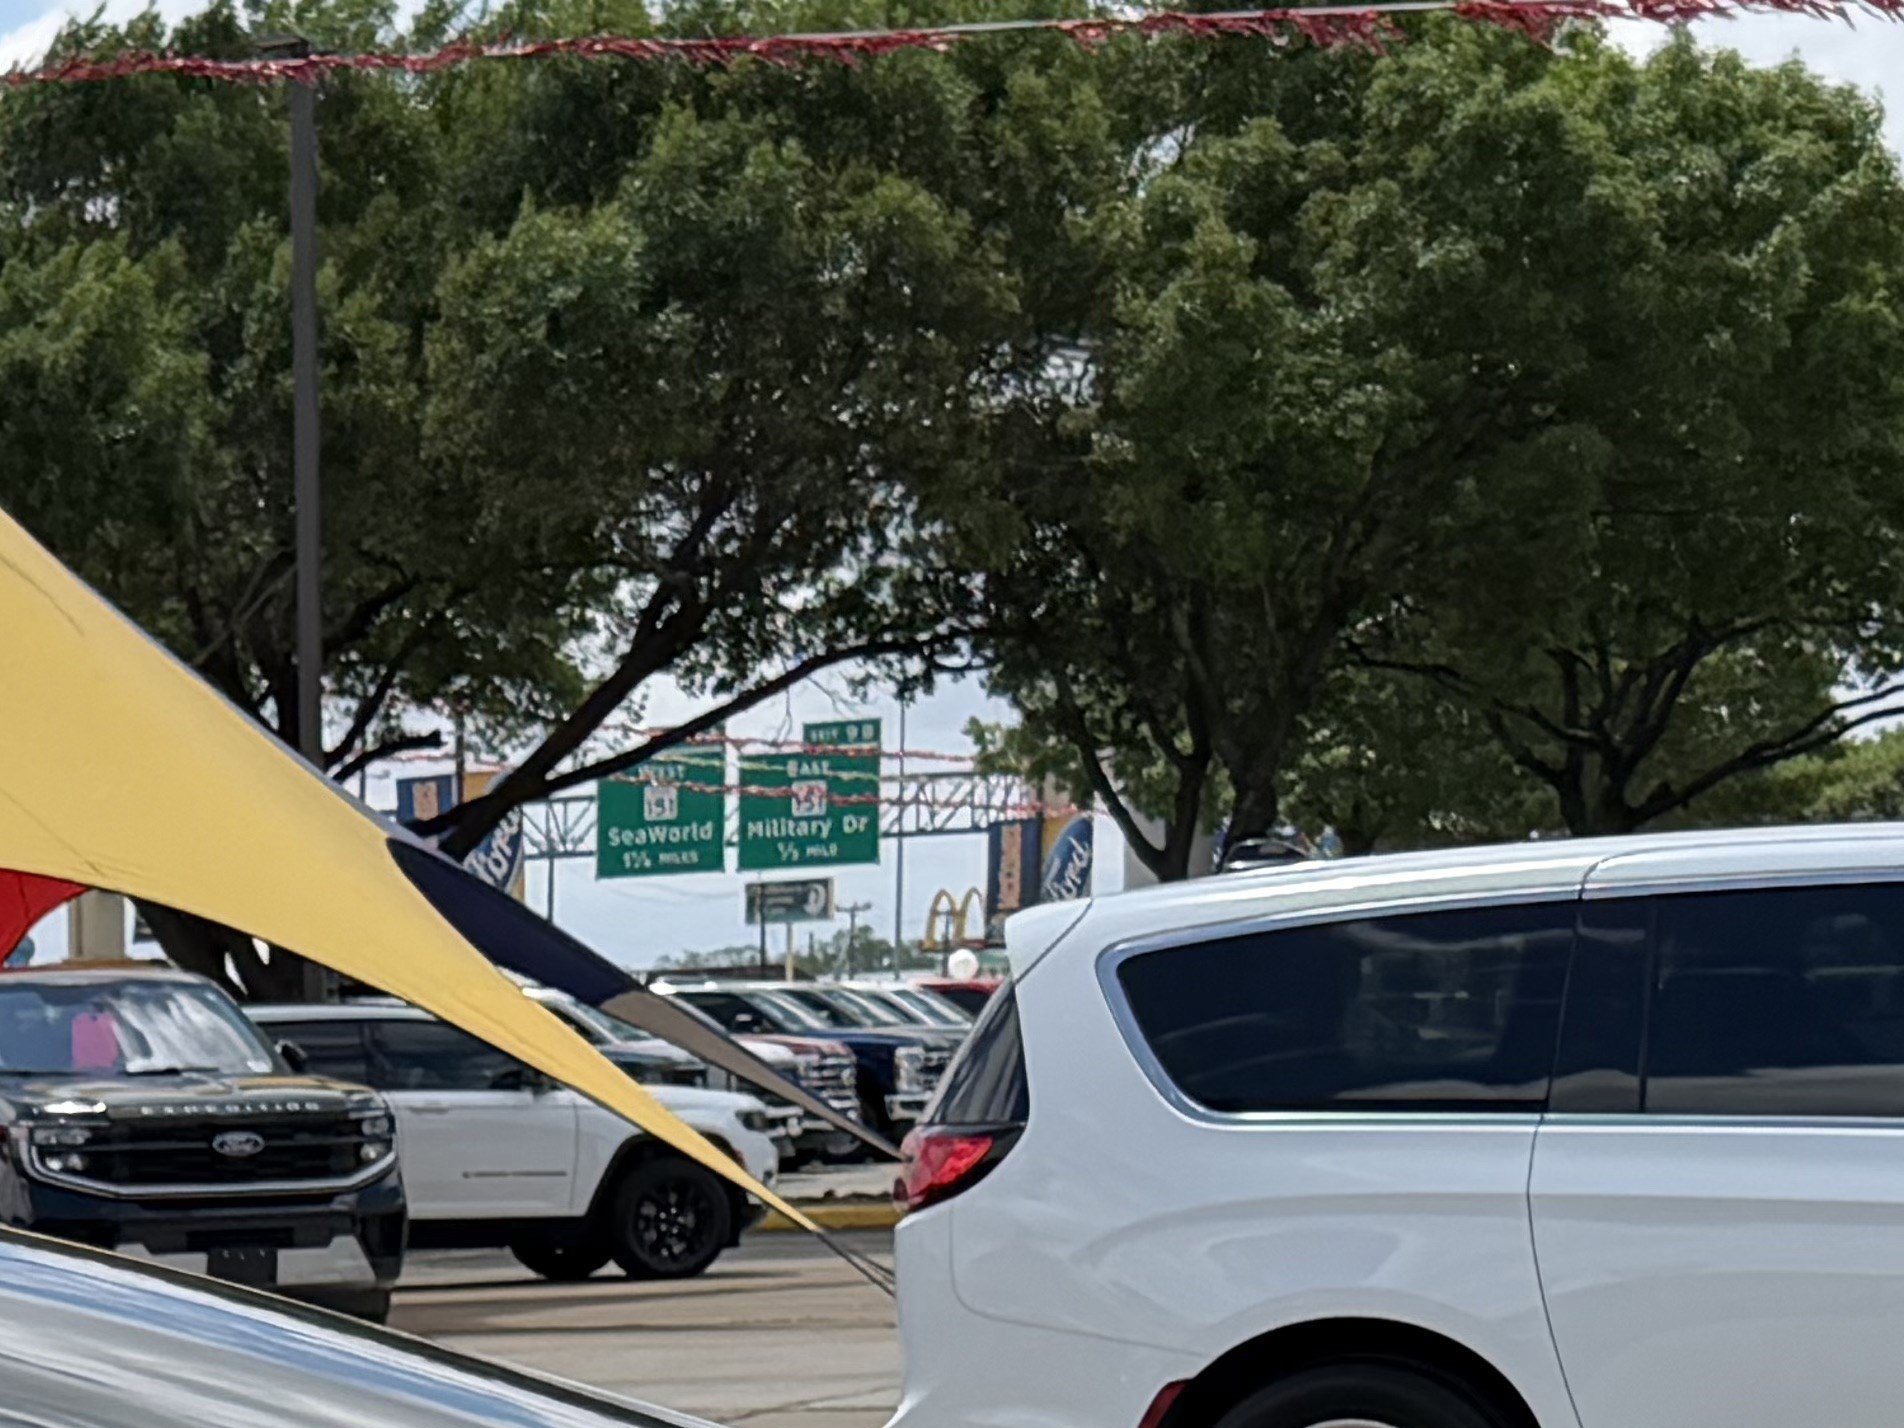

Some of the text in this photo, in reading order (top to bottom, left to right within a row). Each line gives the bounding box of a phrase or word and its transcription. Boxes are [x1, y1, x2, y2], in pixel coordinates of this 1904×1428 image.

[608, 820, 714, 847] SeaWorld
[747, 815, 870, 841] Military Dr
